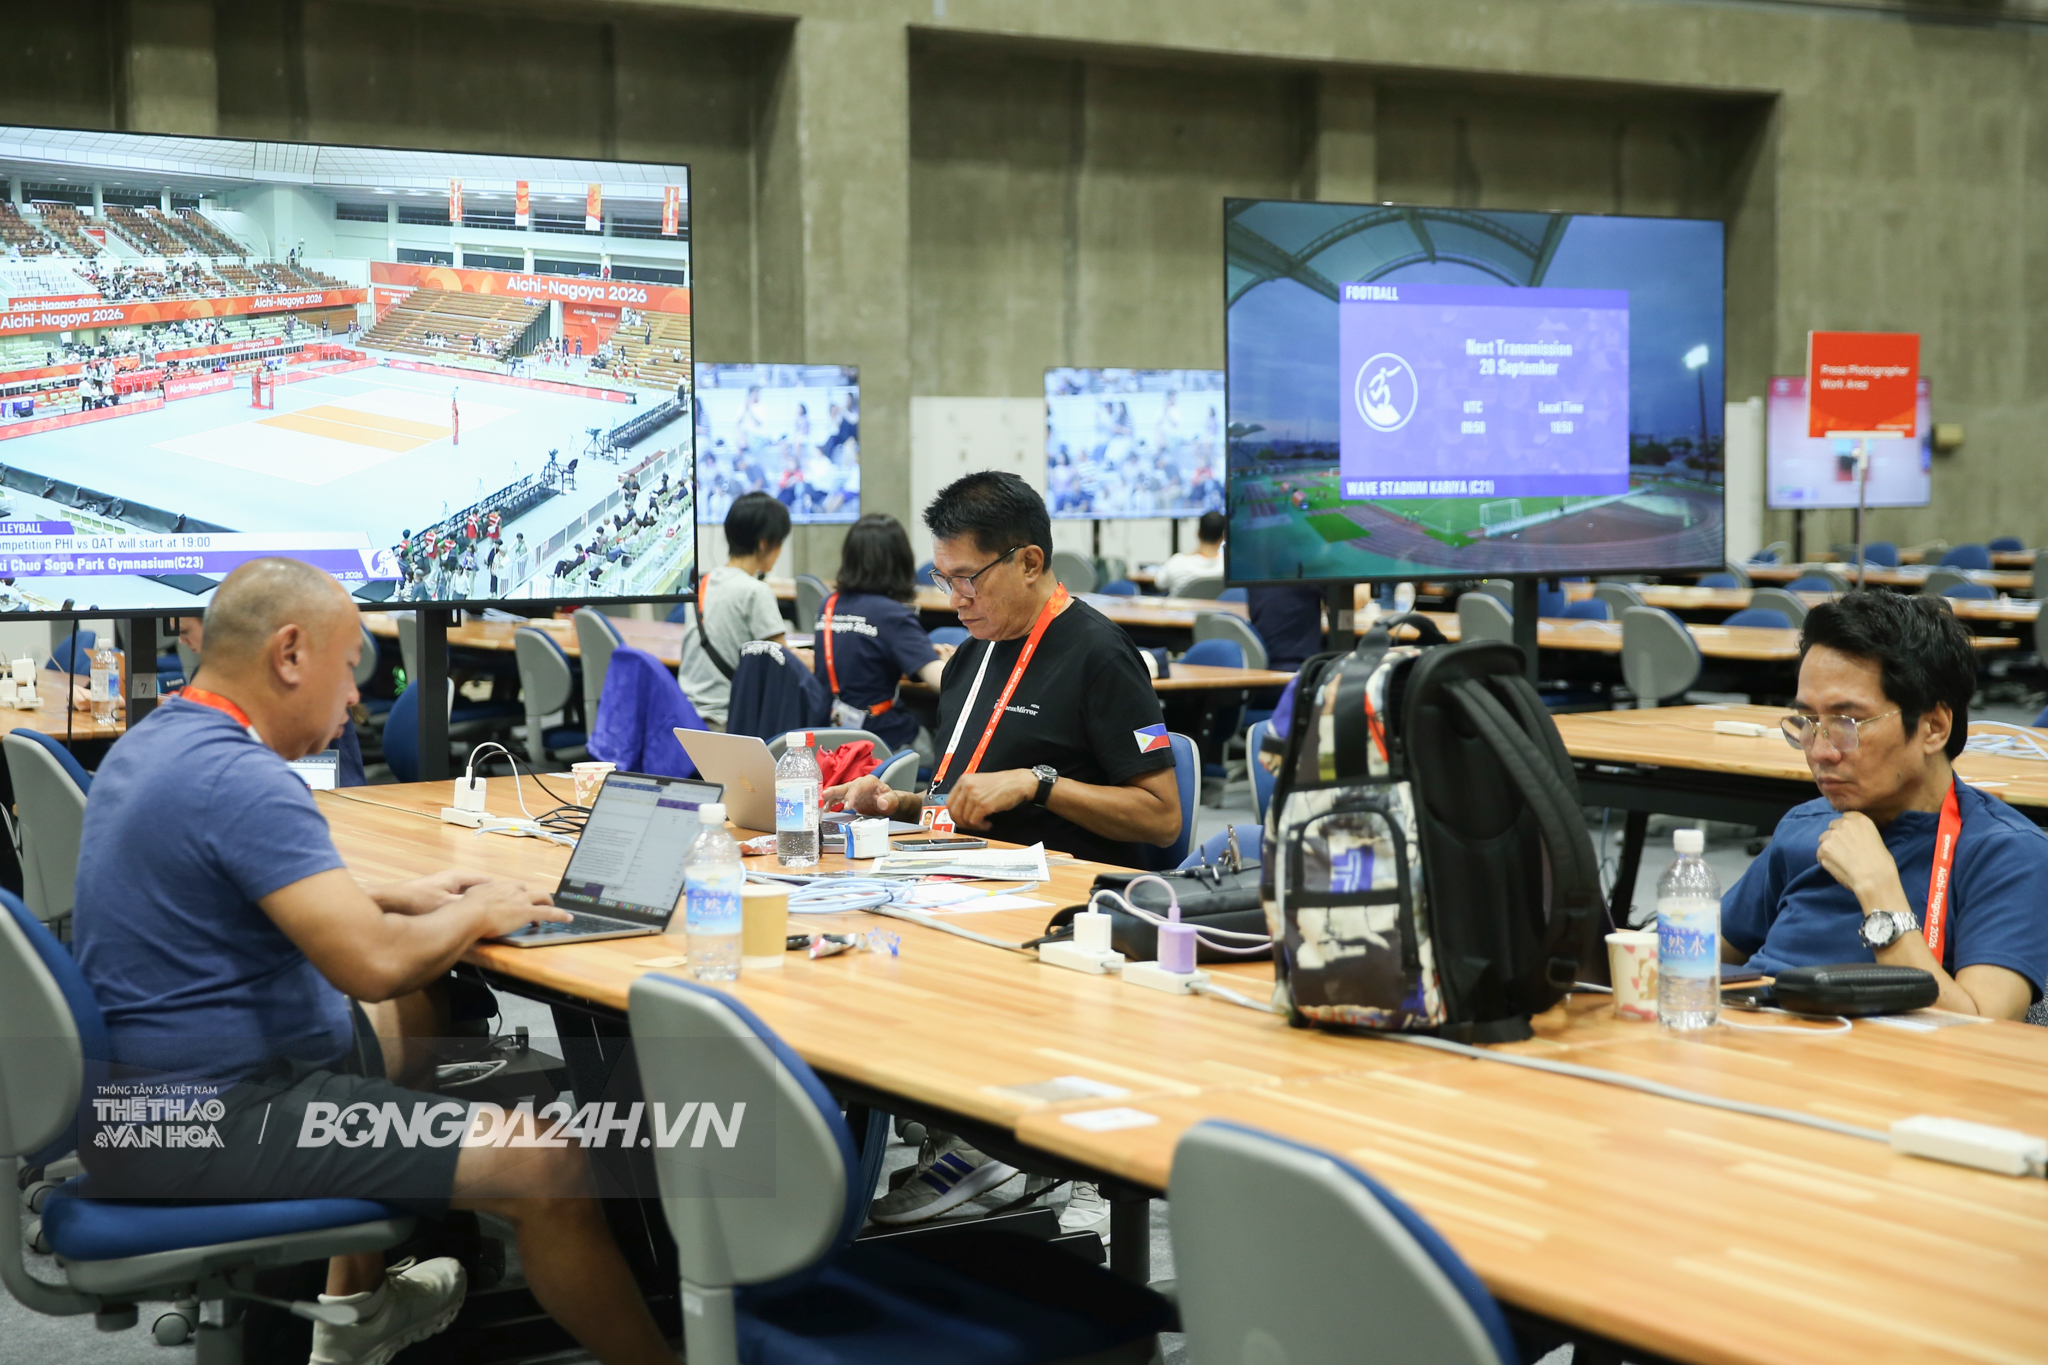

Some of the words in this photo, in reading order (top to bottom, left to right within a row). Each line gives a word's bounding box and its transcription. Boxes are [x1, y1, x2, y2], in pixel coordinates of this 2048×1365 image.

[506, 276, 605, 302] Aichi-Nagoya
[608, 286, 648, 303] 2026
[1346, 286, 1399, 301] FOOTBALL
[253, 296, 305, 309] Aichi-Nagoya
[305, 293, 323, 305] 2026
[0, 311, 91, 330] Aichi-Nagoya
[1465, 339, 1494, 356] Next
[1496, 339, 1573, 357] Transmission
[1497, 358, 1560, 379] September
[1820, 364, 1847, 376] Press
[1847, 364, 1910, 379] Photographer
[1820, 378, 1844, 390] Work
[1845, 379, 1869, 391] Area
[1538, 401, 1562, 414] Local
[1562, 401, 1584, 414] Time
[1346, 481, 1378, 496] WAVE
[1379, 481, 1428, 495] STADIUM
[0, 538, 51, 552] mpetition
[55, 538, 73, 549] PHI
[77, 540, 88, 549] vs
[92, 537, 114, 549] QAT
[118, 537, 136, 549] will
[139, 538, 163, 549] start
[167, 538, 177, 548] at
[181, 536, 211, 548] 19:00
[11, 559, 41, 571] Chuo
[44, 558, 74, 574] Sogo
[77, 557, 104, 570] Park
[108, 556, 204, 572] Gymnasium(C23)
[344, 571, 364, 580] 2026
[999, 666, 1022, 708] Aichi-Nagoya
[1930, 865, 1948, 926] Aichi-Nagoya
[1928, 925, 1939, 949] 2026
